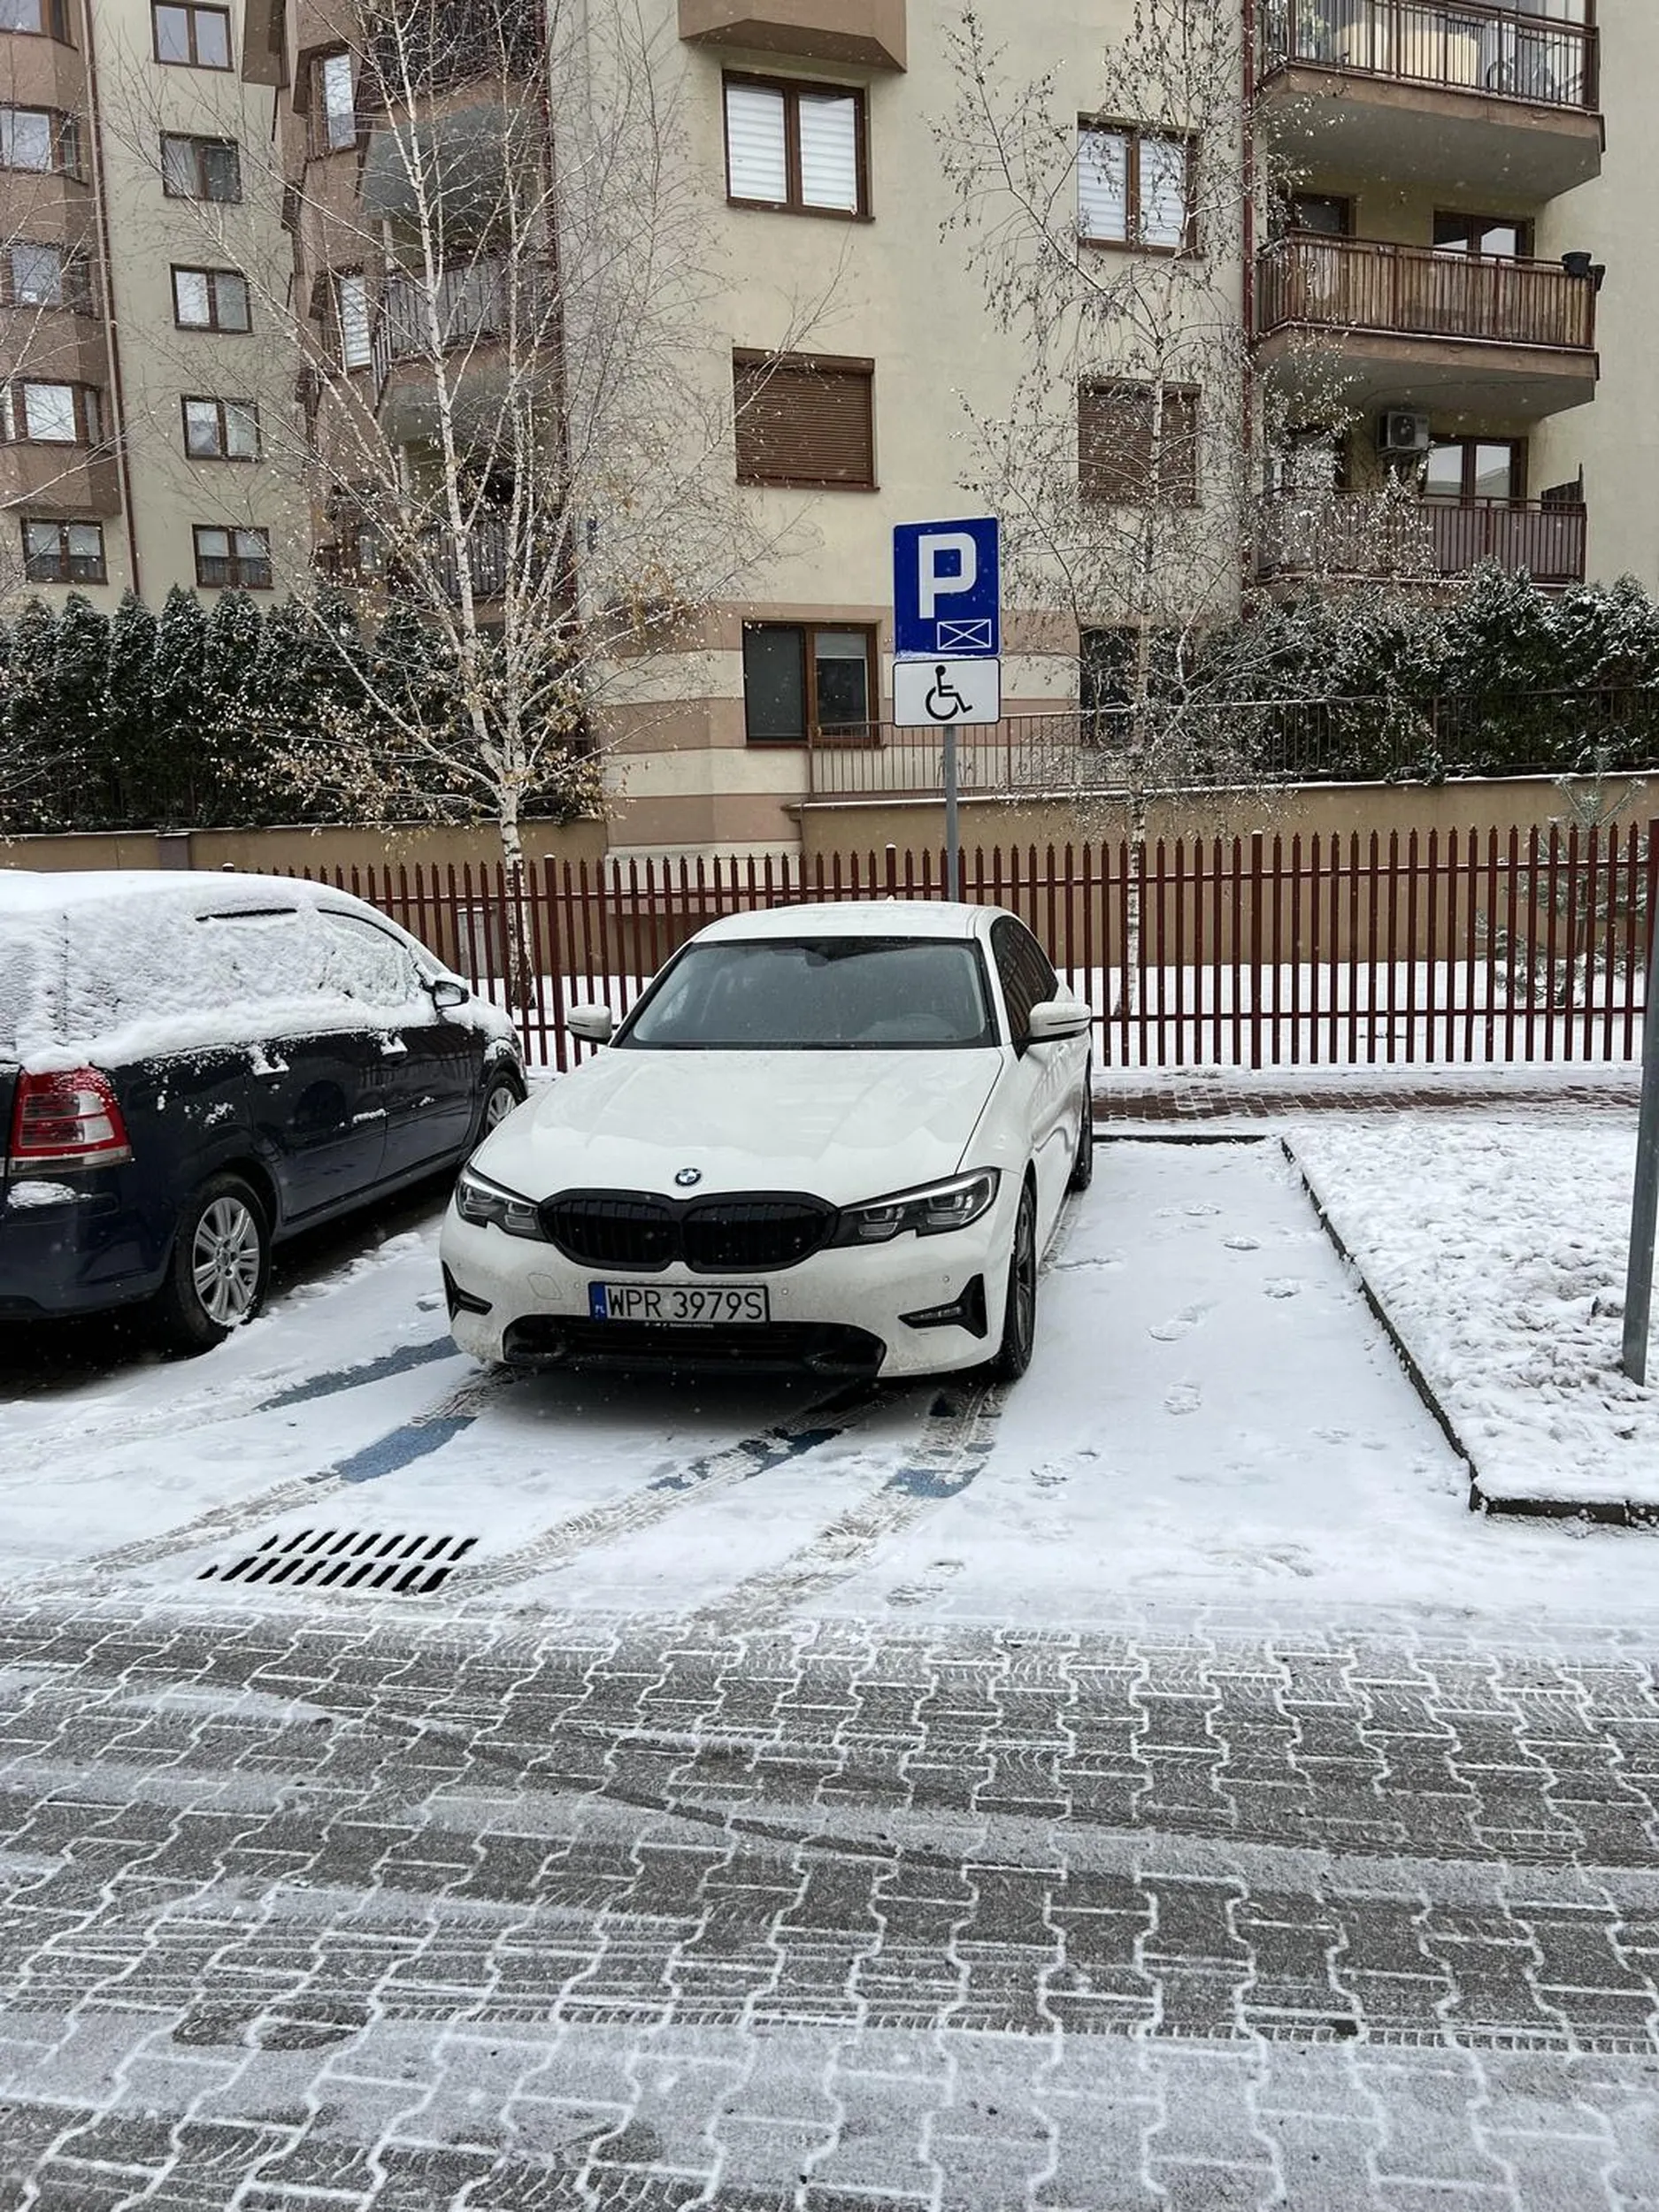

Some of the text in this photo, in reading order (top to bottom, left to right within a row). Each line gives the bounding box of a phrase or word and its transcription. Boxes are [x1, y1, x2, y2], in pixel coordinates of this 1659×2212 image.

[918, 533, 976, 618] P
[608, 1288, 763, 1319] WPR 3979S
